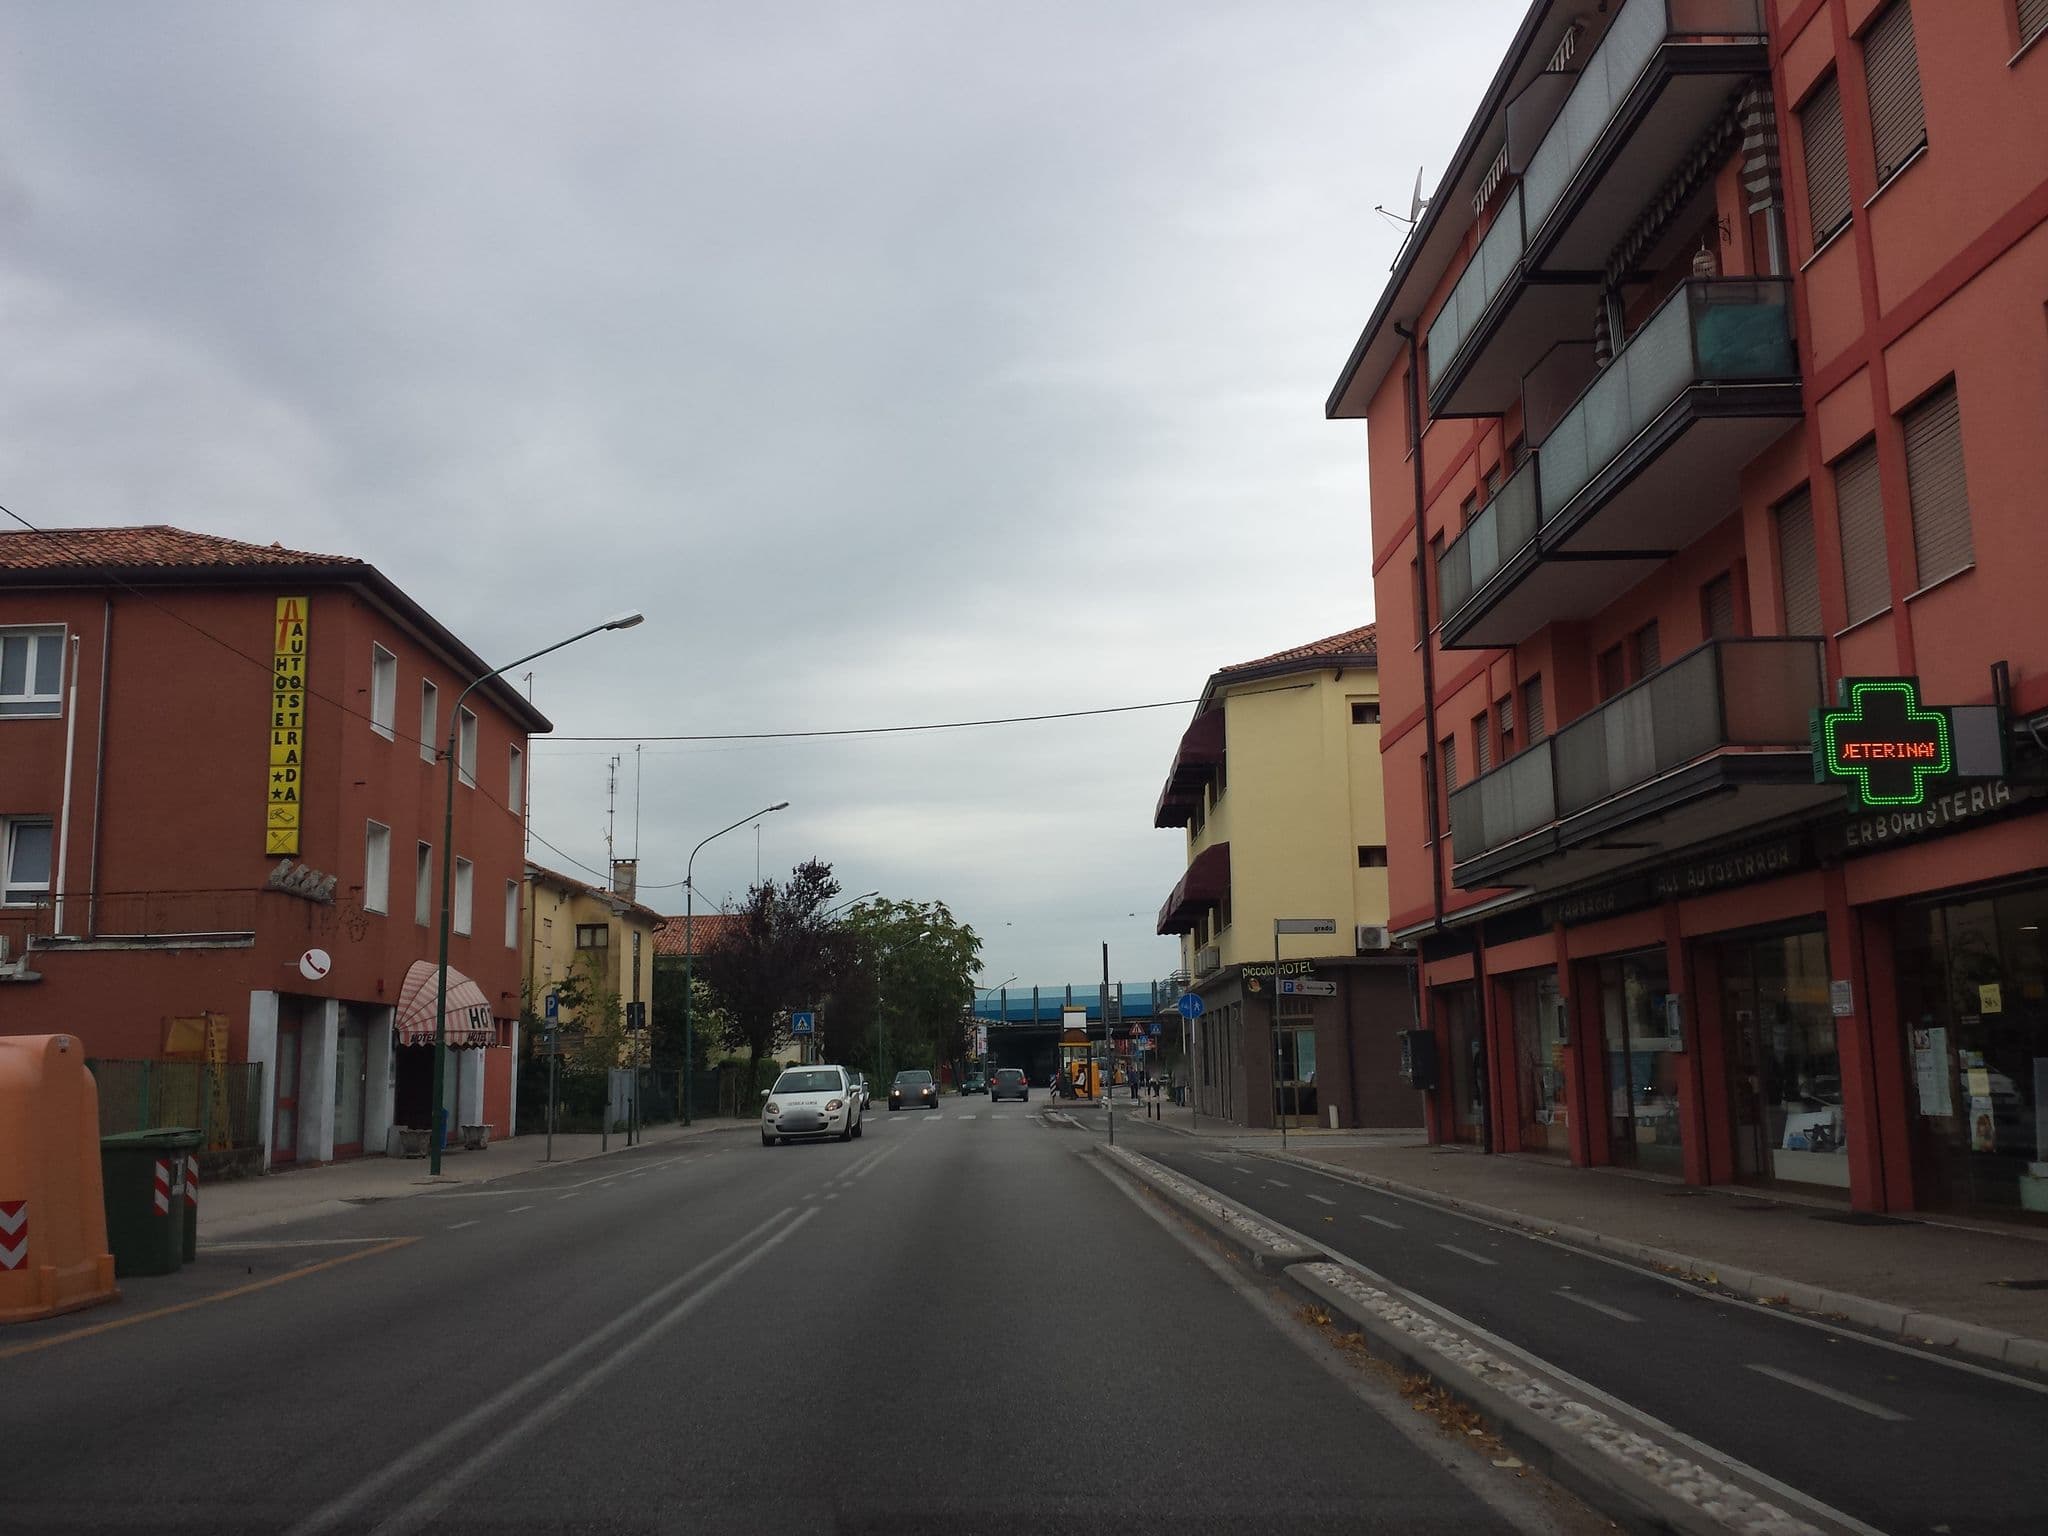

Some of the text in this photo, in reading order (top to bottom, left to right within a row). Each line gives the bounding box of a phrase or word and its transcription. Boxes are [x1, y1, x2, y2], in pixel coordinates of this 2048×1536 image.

[274, 657, 288, 746] HOTEL
[284, 623, 304, 801] AUTOSTRADA
[1846, 780, 2011, 847] ERBORISTERIA
[1242, 962, 1315, 979] piccolo HOTEL
[547, 997, 555, 1016] P
[410, 1031, 436, 1043] HOTEL
